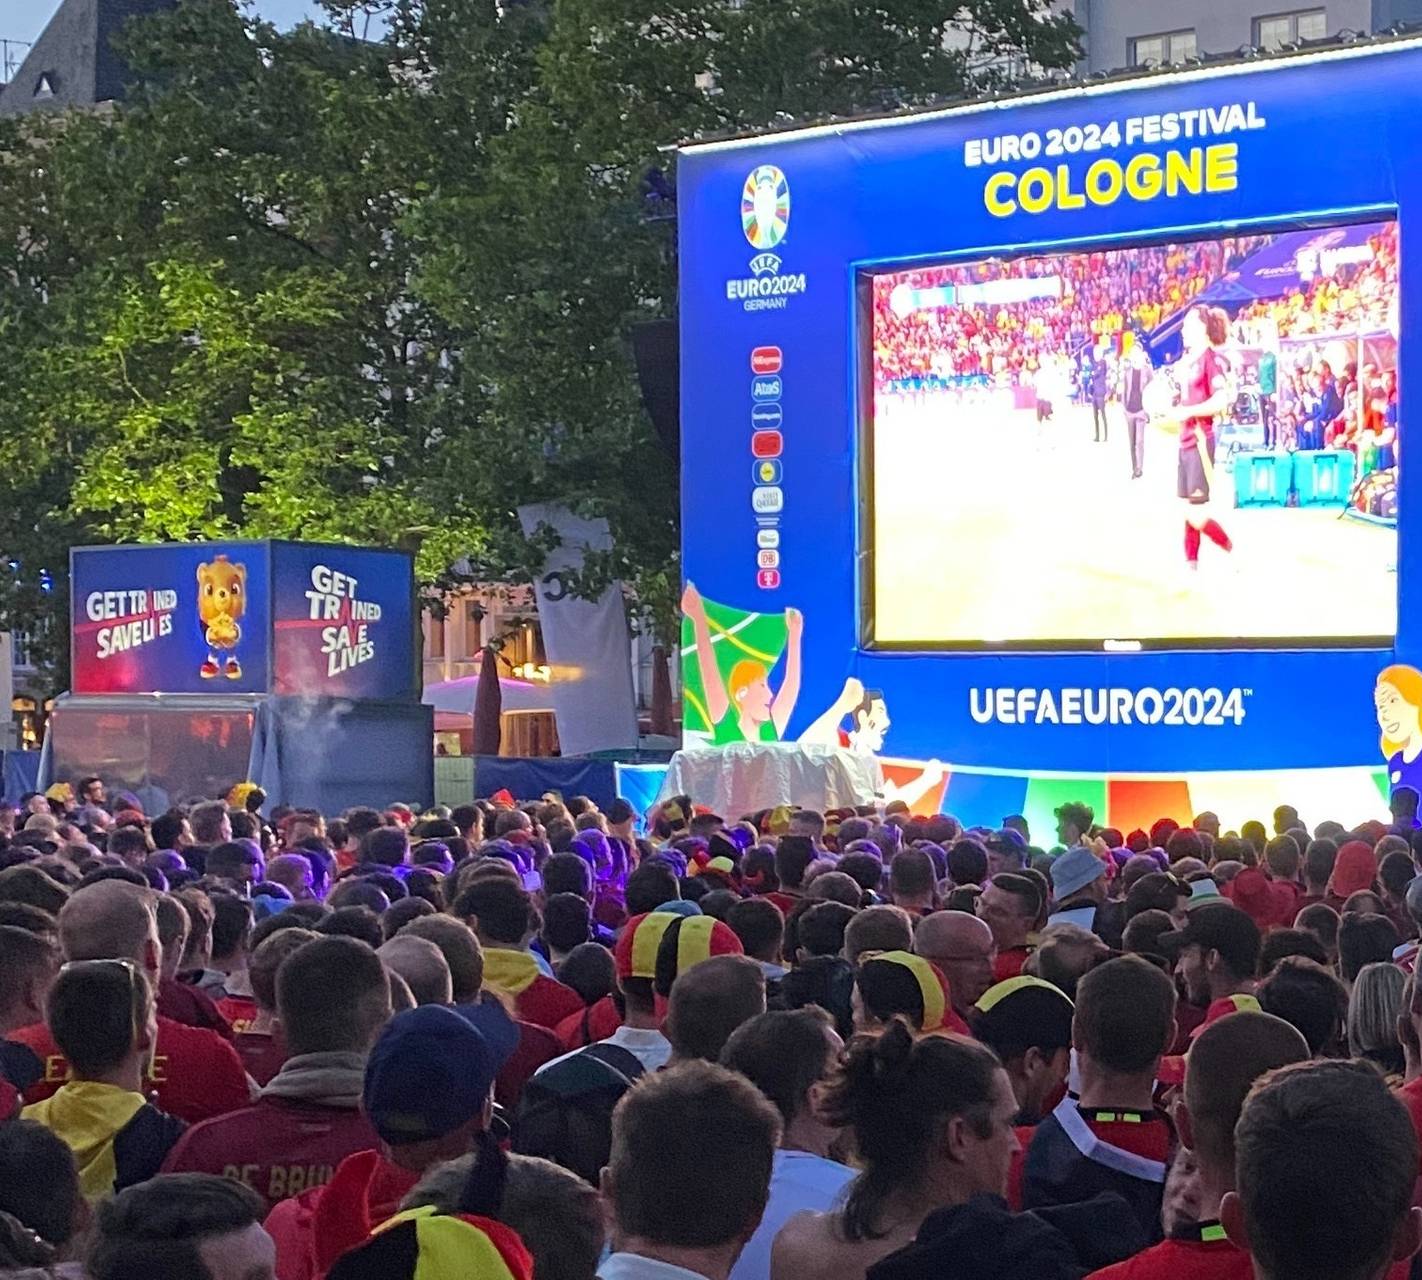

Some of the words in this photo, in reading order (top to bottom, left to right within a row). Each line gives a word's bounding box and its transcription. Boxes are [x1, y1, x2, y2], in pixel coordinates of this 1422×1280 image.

[964, 133, 1041, 167] EURO
[1045, 121, 1121, 155] 2024
[1126, 101, 1266, 144] FESTIVAL
[984, 143, 1239, 217] COLOGNE
[750, 256, 781, 273] UEFA
[726, 273, 806, 299] EURO2024
[743, 297, 788, 311] GERMANY
[311, 565, 357, 599] GET
[86, 591, 127, 622] GET
[96, 621, 142, 659] SAVE
[327, 641, 375, 677] LIVES
